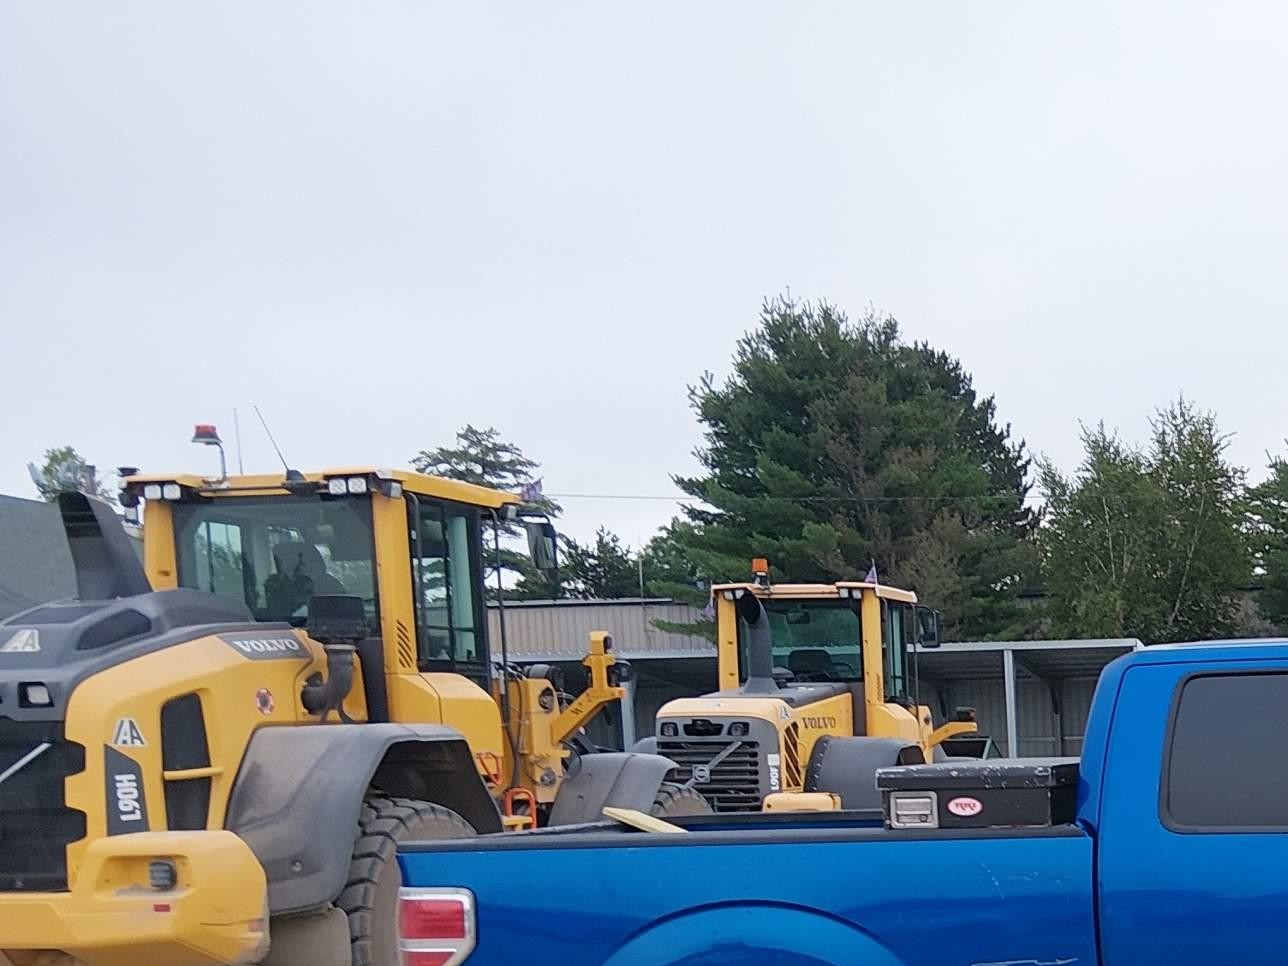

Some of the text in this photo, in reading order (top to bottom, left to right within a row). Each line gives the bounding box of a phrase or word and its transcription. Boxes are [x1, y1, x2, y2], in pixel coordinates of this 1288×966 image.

[232, 638, 300, 653] VOLVO
[802, 717, 836, 729] VOLVO
[114, 773, 142, 822] L90H
